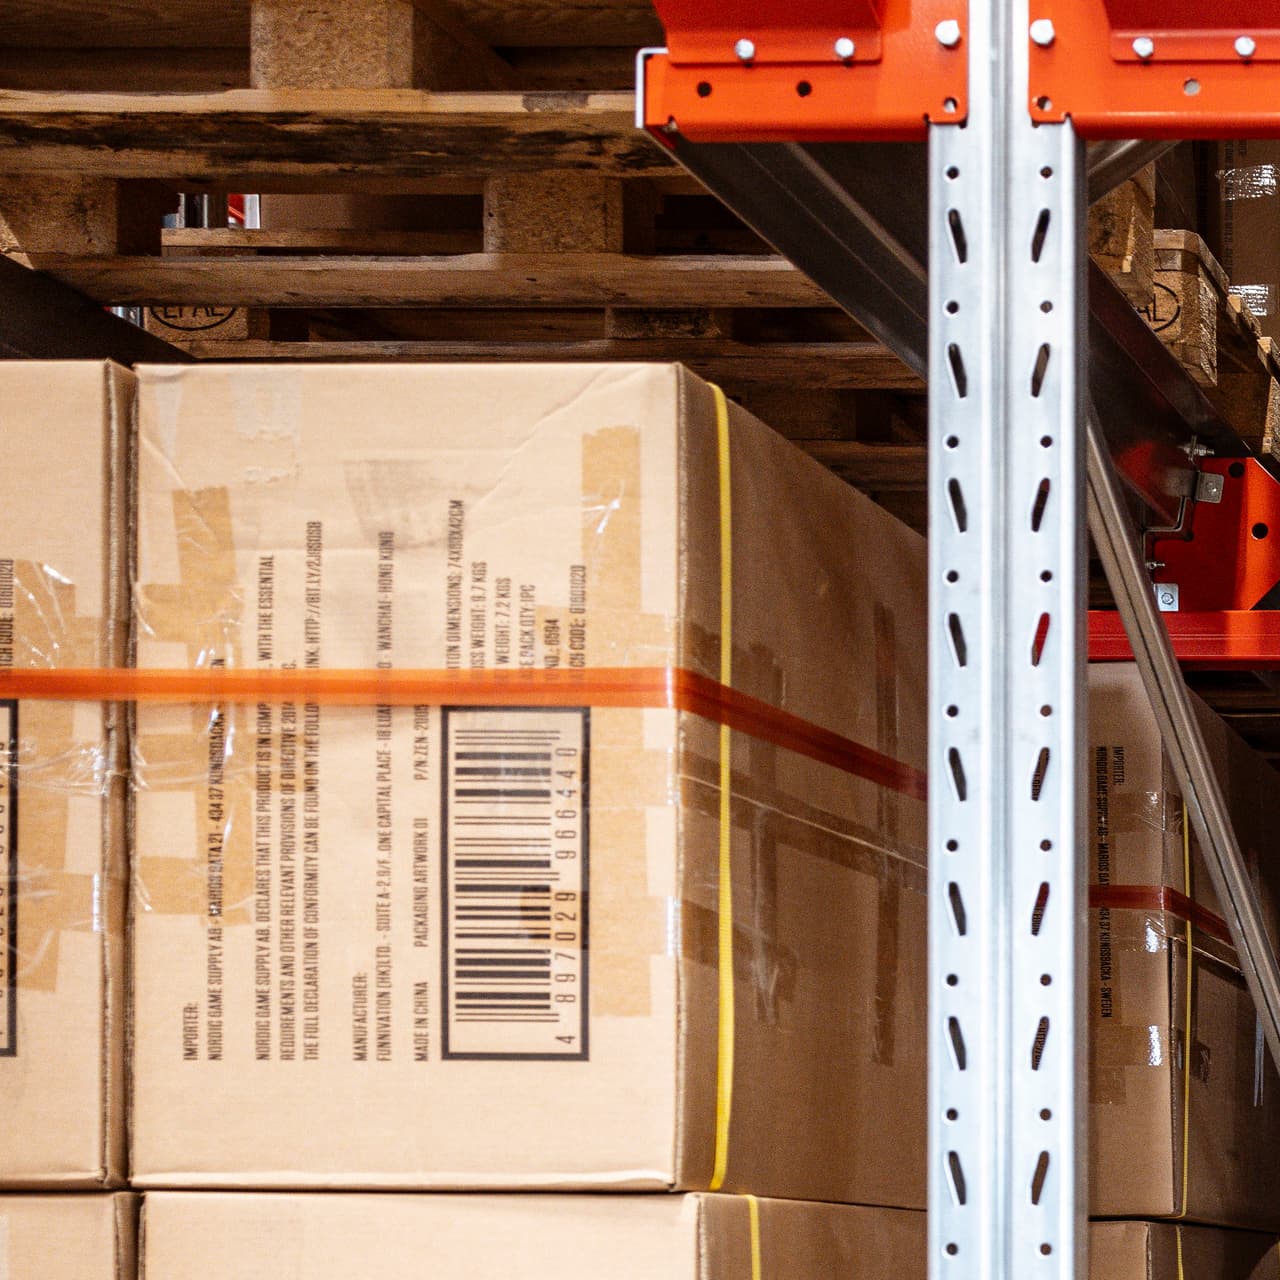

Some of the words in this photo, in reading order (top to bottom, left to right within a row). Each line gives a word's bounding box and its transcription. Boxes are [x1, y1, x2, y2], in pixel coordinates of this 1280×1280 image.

[258, 557, 274, 609] ESSENTIAL
[470, 562, 488, 582] KGS
[470, 585, 487, 601] 9.7
[258, 612, 274, 630] THE
[470, 605, 487, 648] WEIGHT:
[258, 634, 273, 660] WITH
[280, 727, 297, 779] DIRECTIVE
[1112, 746, 1124, 785] IMPORTER:
[208, 787, 224, 800] 37
[256, 764, 273, 812] PRODUCT
[280, 784, 297, 794] OF
[208, 803, 224, 822] 434
[256, 815, 272, 837] THIS
[280, 798, 297, 861] PROVISIONS
[304, 832, 320, 852] CAN
[256, 842, 272, 865] THAT
[414, 832, 428, 883] ARTWORK
[256, 869, 272, 921] DECLARES
[280, 865, 296, 915] RELEVANT
[304, 856, 320, 923] CONFORMITY
[414, 886, 428, 947] PACKAGING
[208, 928, 223, 941] AB
[280, 919, 296, 952] OTHER
[207, 945, 223, 984] SUPPLY
[280, 955, 296, 976] AND
[207, 990, 223, 1016] GAME
[414, 982, 428, 1014] CHINA
[184, 1003, 198, 1060] IMPORTER:
[280, 980, 296, 1059] REQUIREMENTS
[304, 1015, 319, 1038] FULL
[353, 973, 368, 1060] MANUFACTURER:
[207, 1020, 223, 1059] NORDIC
[414, 1033, 428, 1060] MADE
